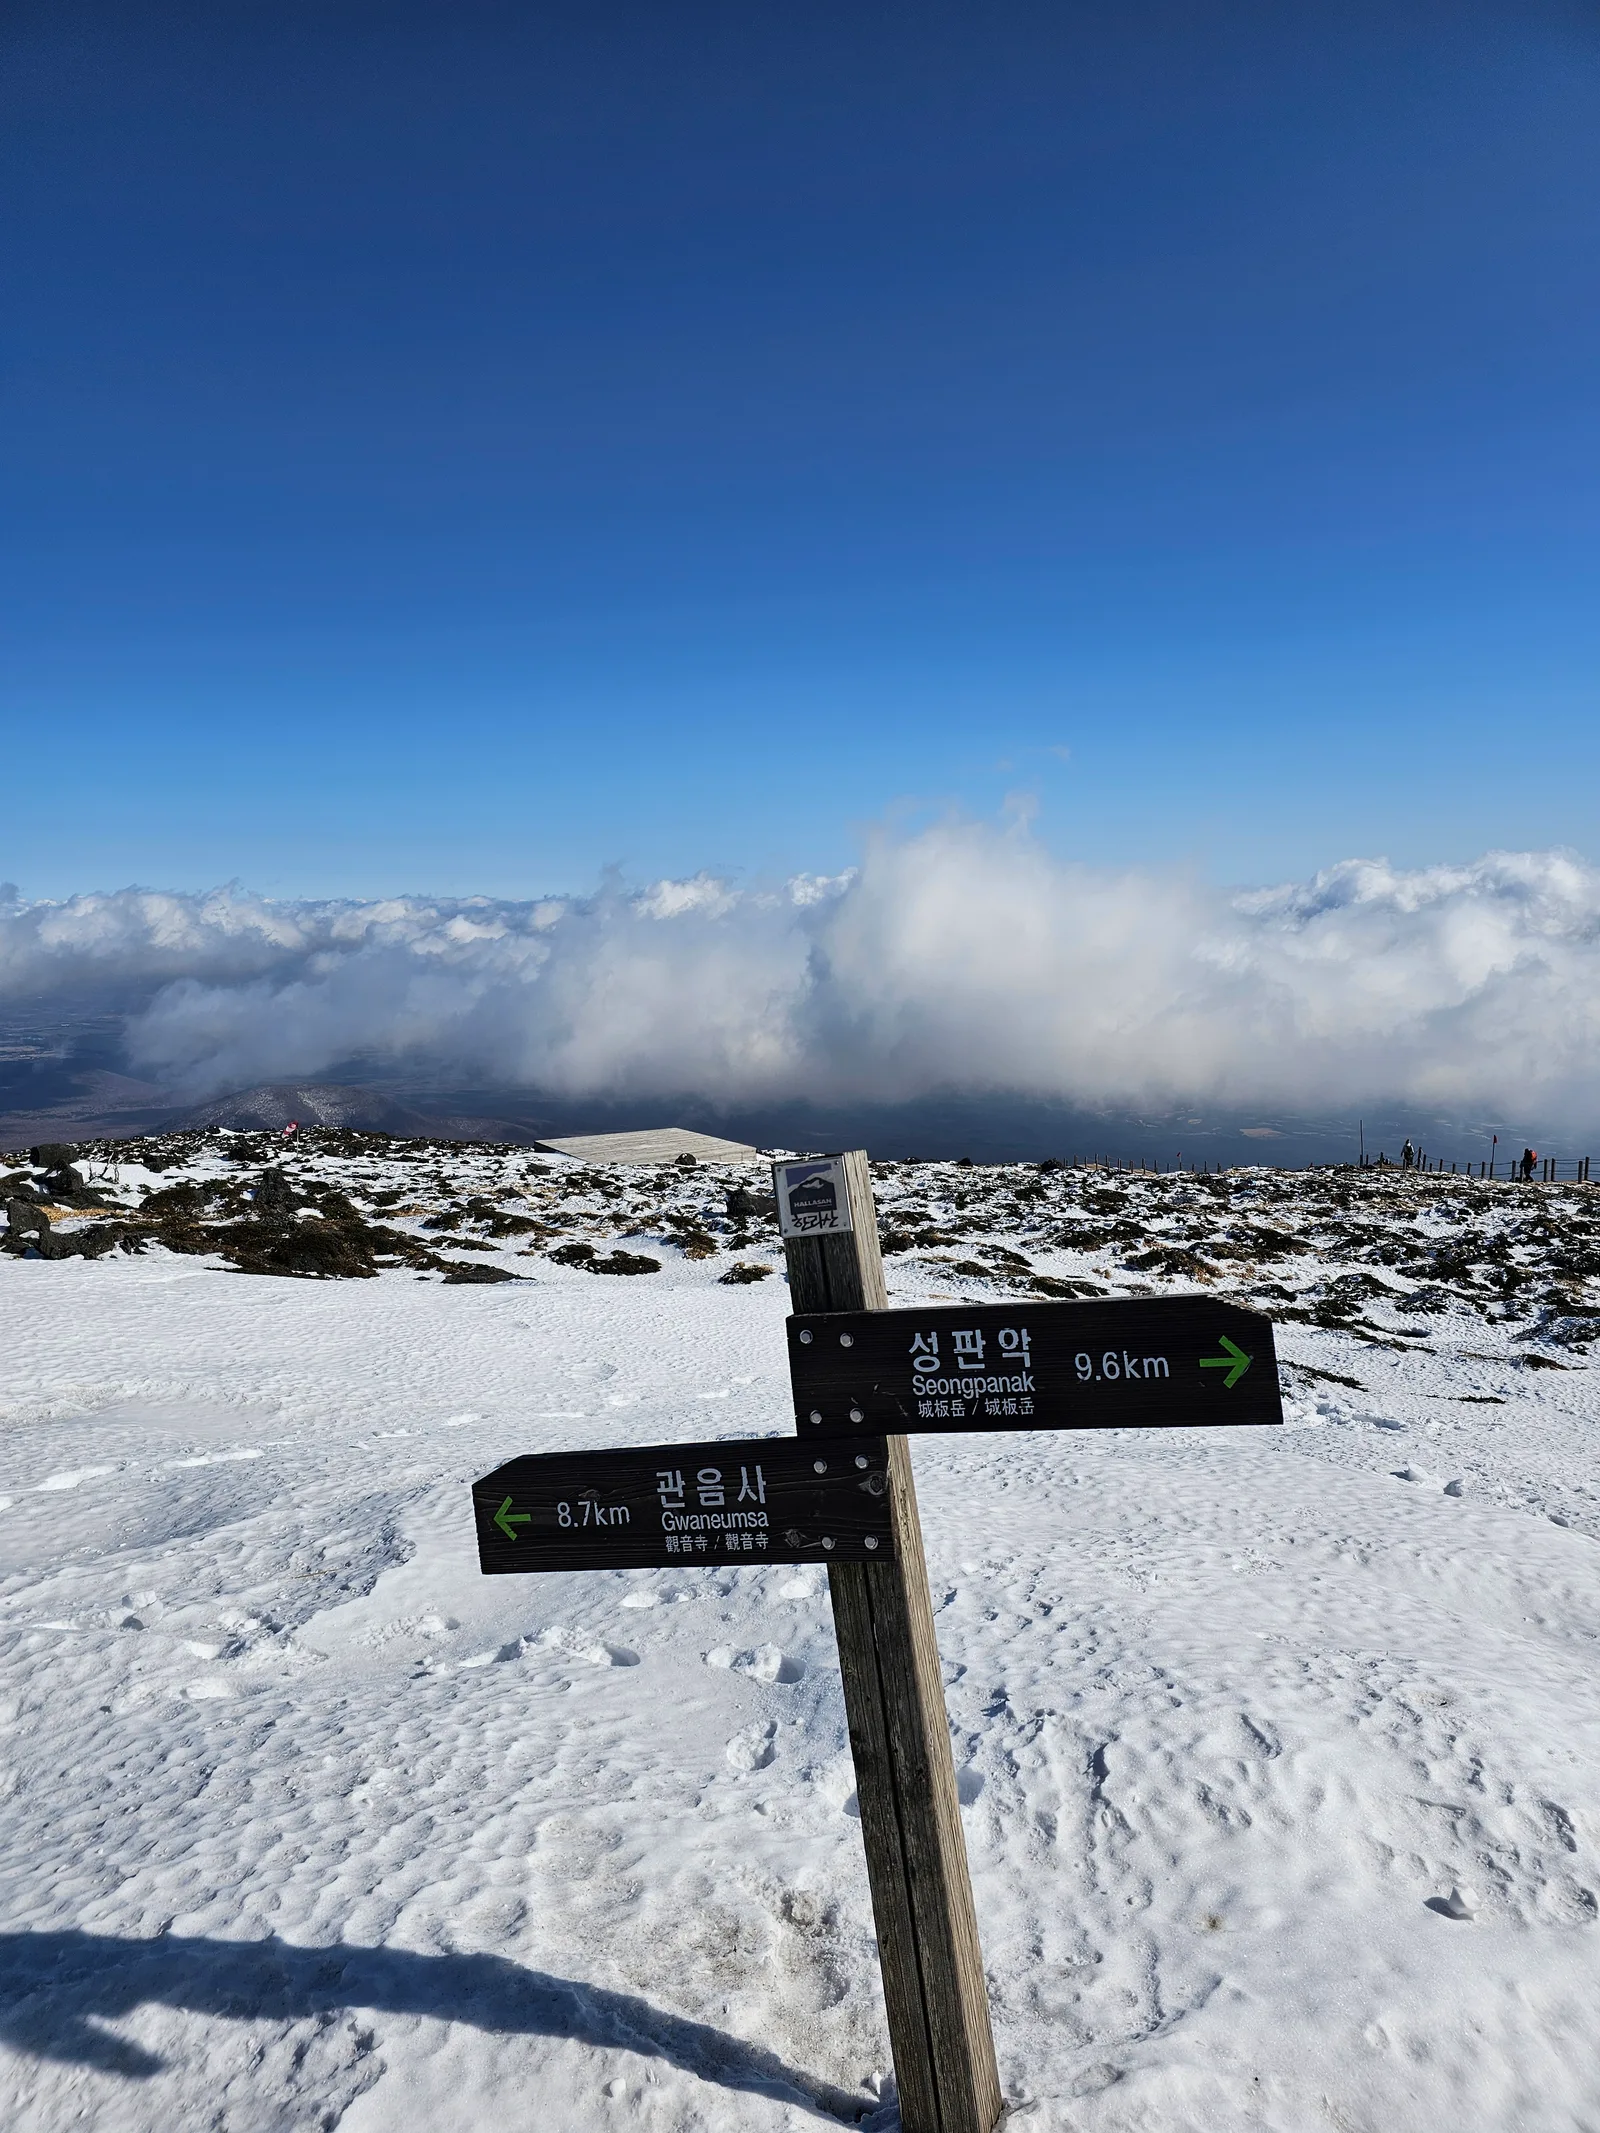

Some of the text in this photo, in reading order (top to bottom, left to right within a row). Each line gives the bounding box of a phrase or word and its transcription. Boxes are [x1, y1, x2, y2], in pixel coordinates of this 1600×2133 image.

[793, 1198, 832, 1208] HALLASAN
[908, 1328, 1032, 1373] 성판악
[1074, 1351, 1170, 1382] 9.6km
[912, 1371, 1036, 1399] Seongpanak
[656, 1465, 767, 1508] 관음사
[557, 1501, 631, 1528] 8.7km
[661, 1511, 770, 1532] Gwaneumsa
